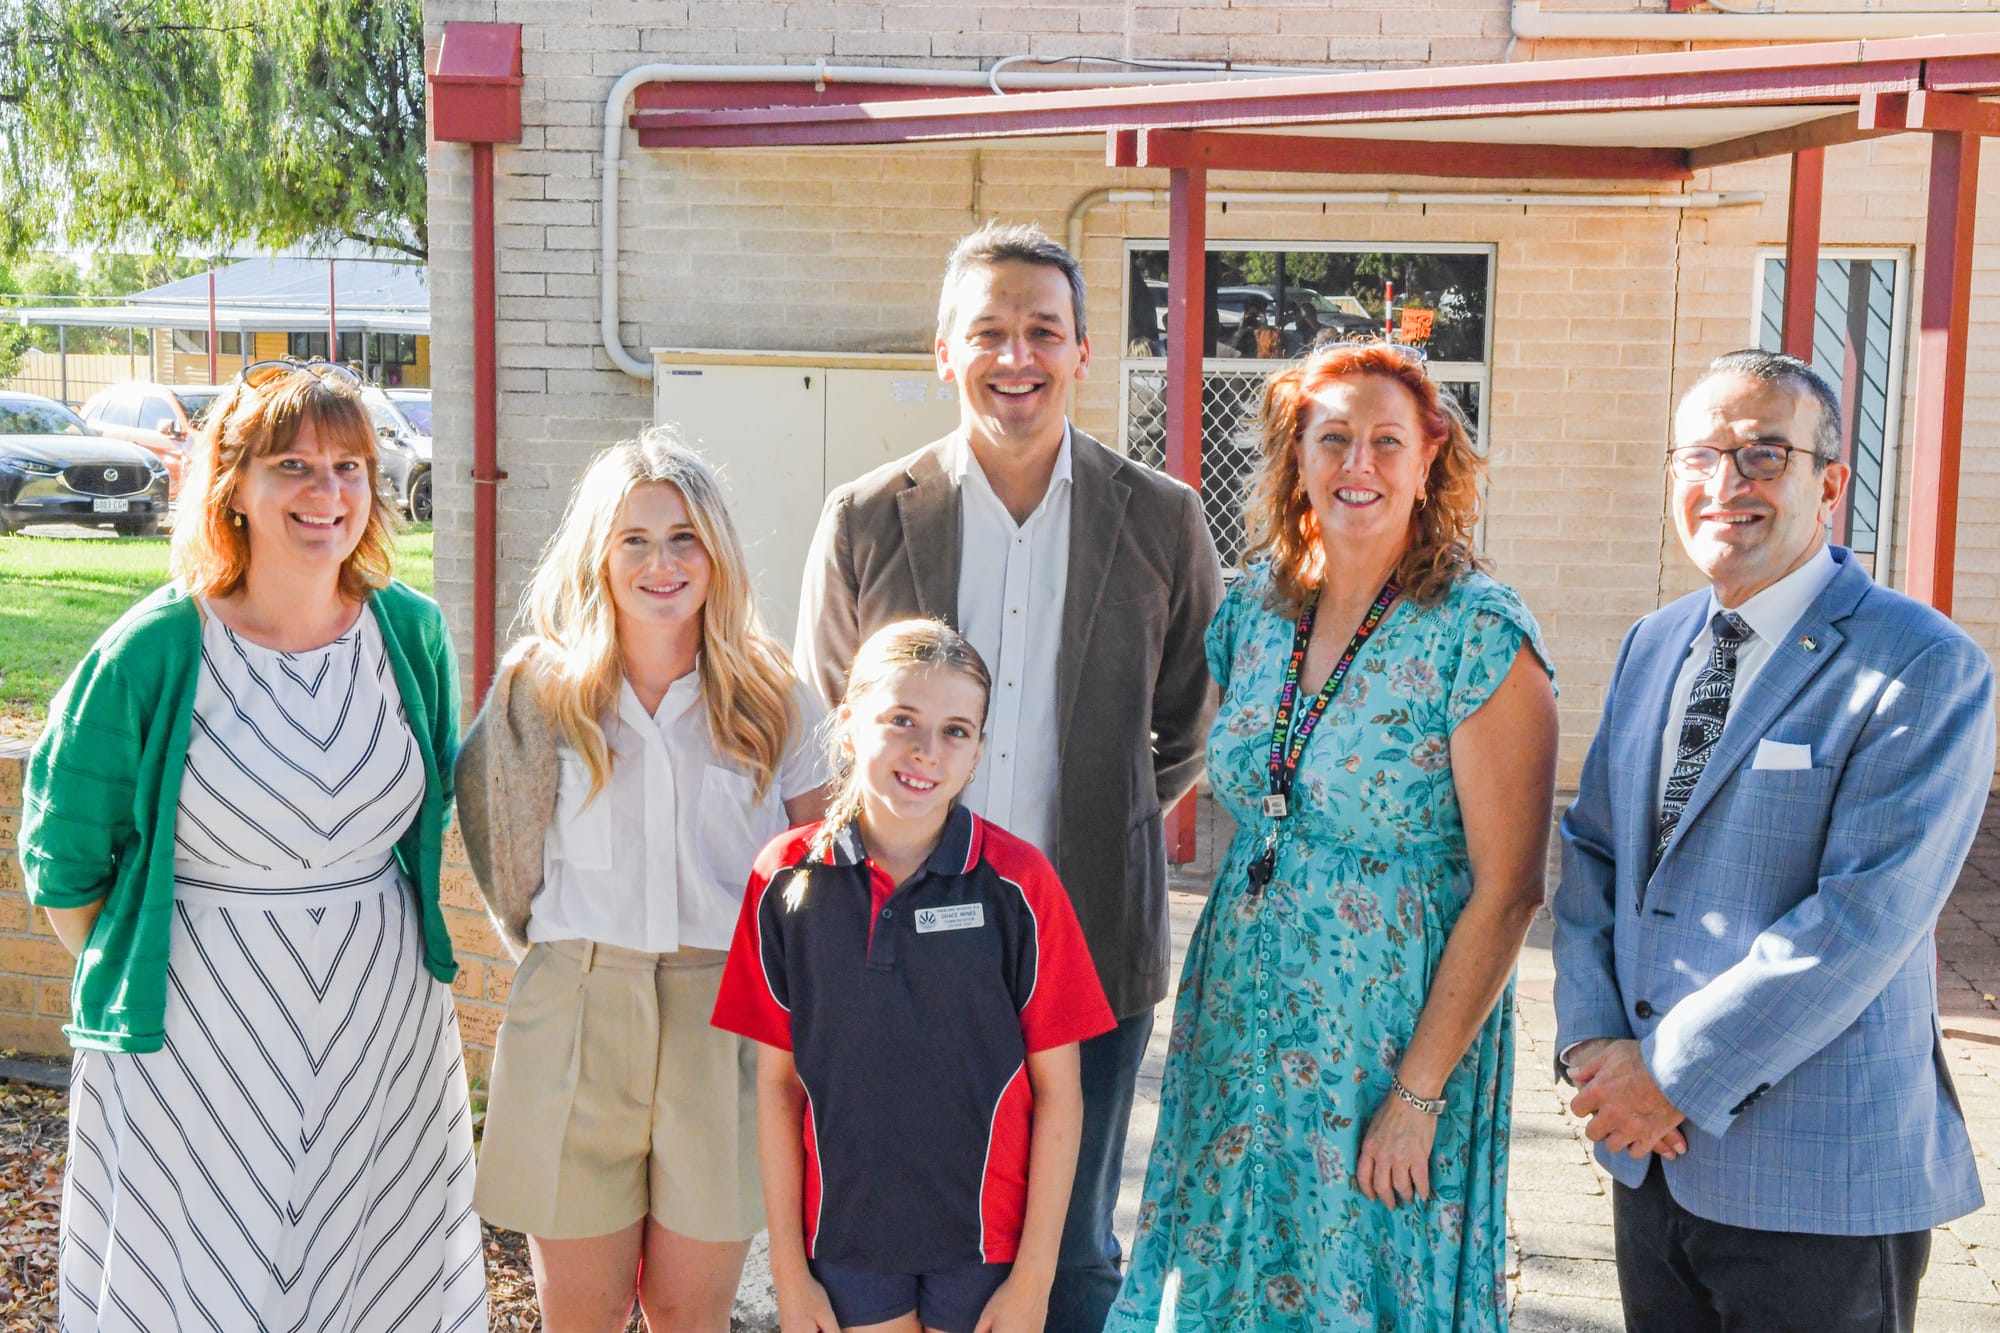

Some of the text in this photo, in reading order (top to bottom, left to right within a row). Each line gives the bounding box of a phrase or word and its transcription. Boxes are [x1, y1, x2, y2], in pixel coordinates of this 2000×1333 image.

[1357, 583, 1398, 636] Festival
[1271, 651, 1304, 771] Festival of Music
[1286, 654, 1353, 769] Festival of Music
